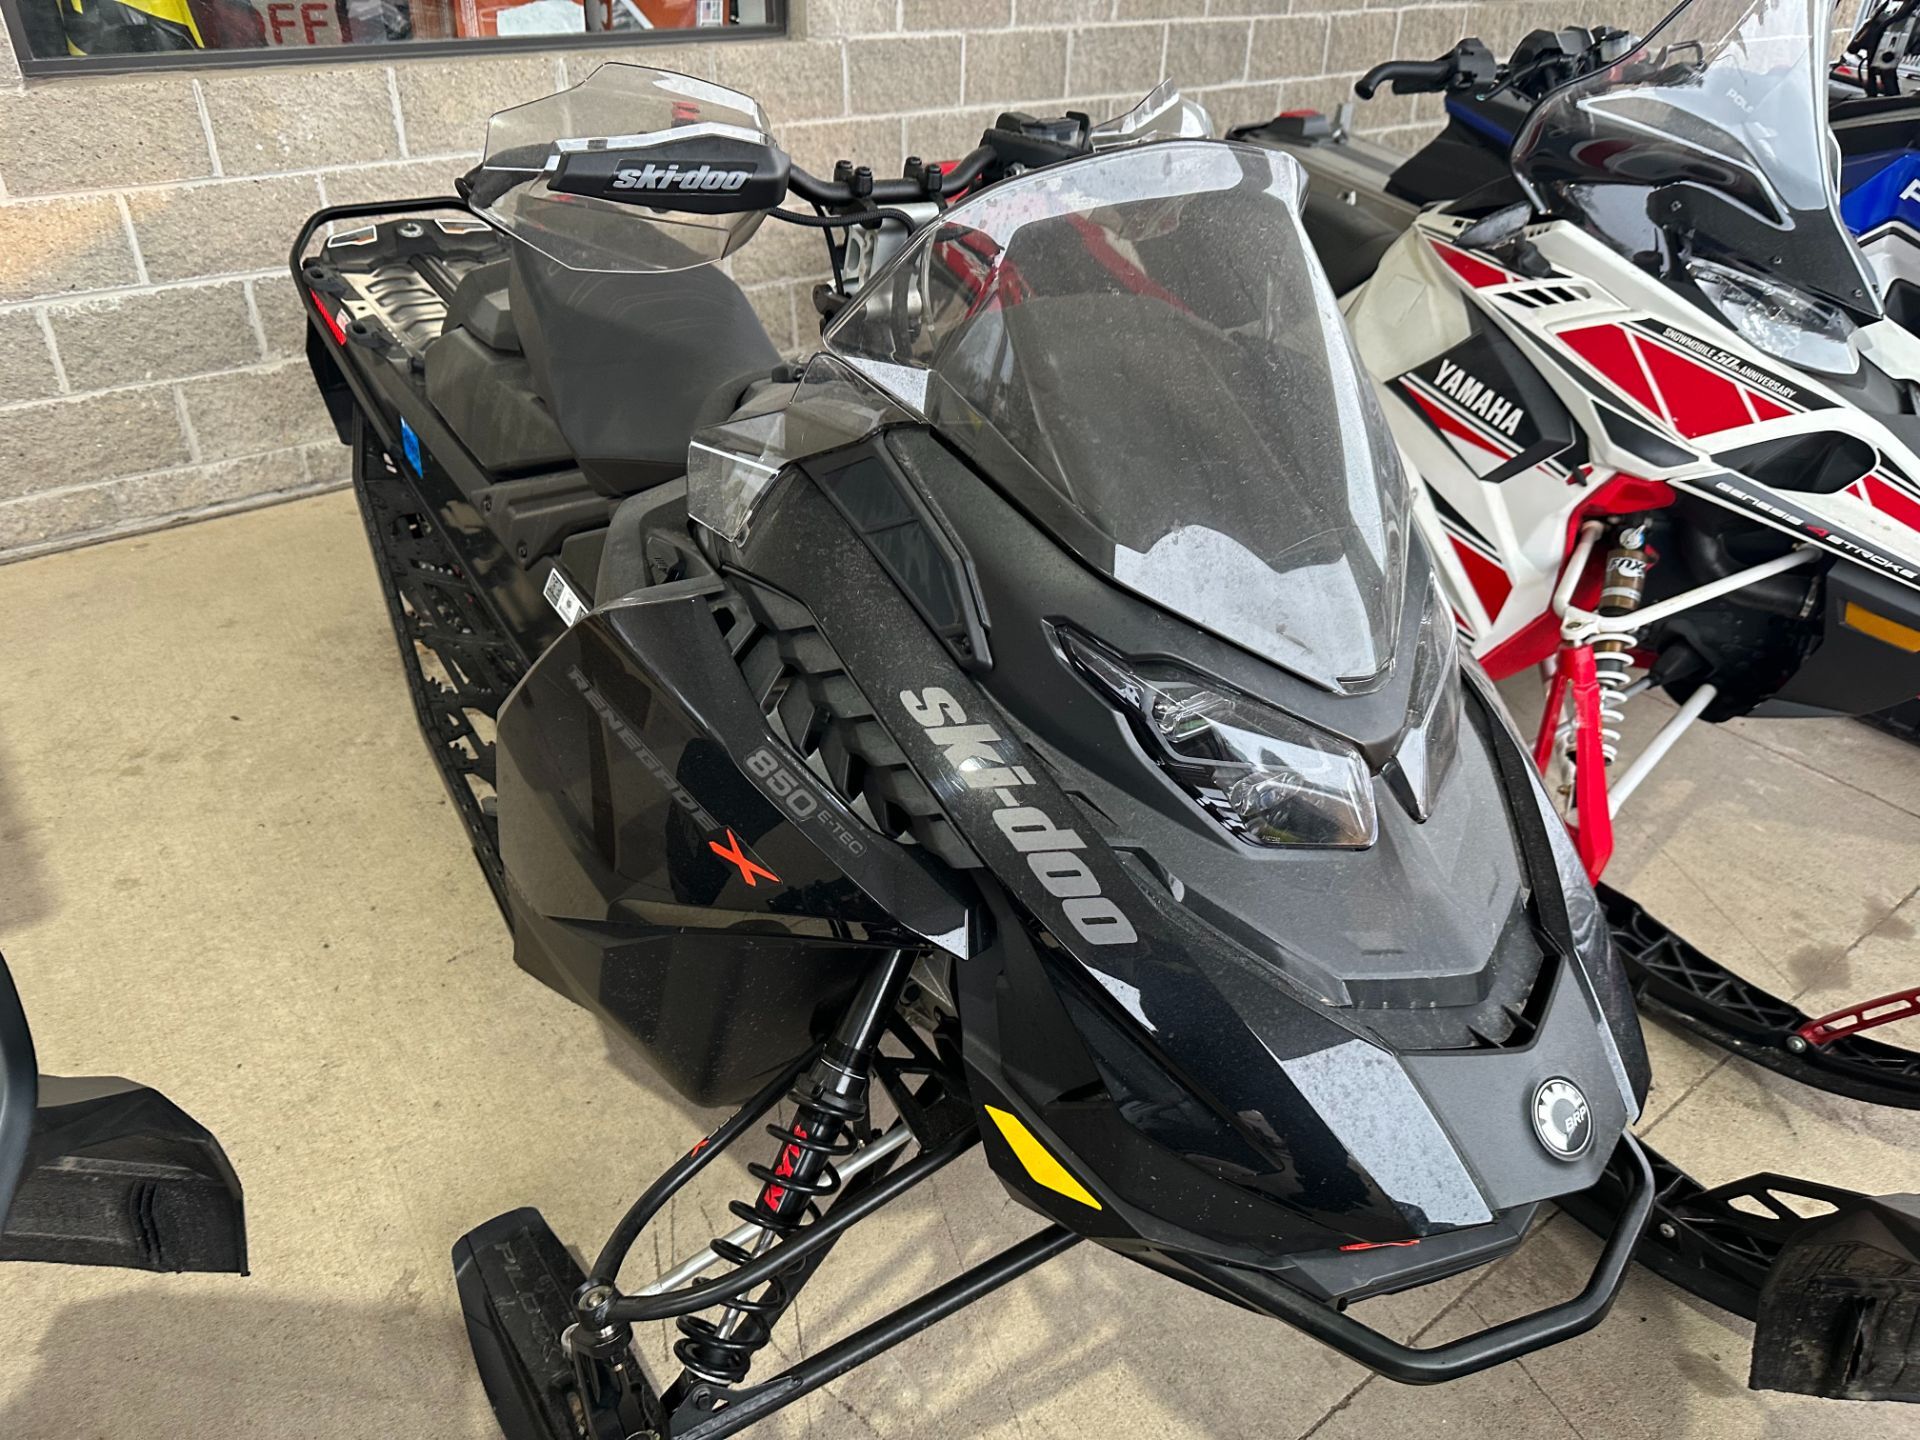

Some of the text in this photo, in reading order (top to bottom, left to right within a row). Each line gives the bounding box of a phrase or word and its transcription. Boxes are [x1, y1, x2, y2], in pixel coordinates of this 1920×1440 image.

[612, 163, 753, 190] ski-doo
[1433, 359, 1524, 436] YAMAHA
[1662, 327, 1717, 358] SNOWMOBILE
[1739, 365, 1797, 399] ANNIVERSARY
[1715, 481, 1805, 526] GENESIS
[567, 664, 782, 886] RENEGADE X
[746, 749, 864, 855] 850 E-TEC
[899, 687, 1138, 945] ski-doo
[1565, 1105, 1587, 1132] BRP
